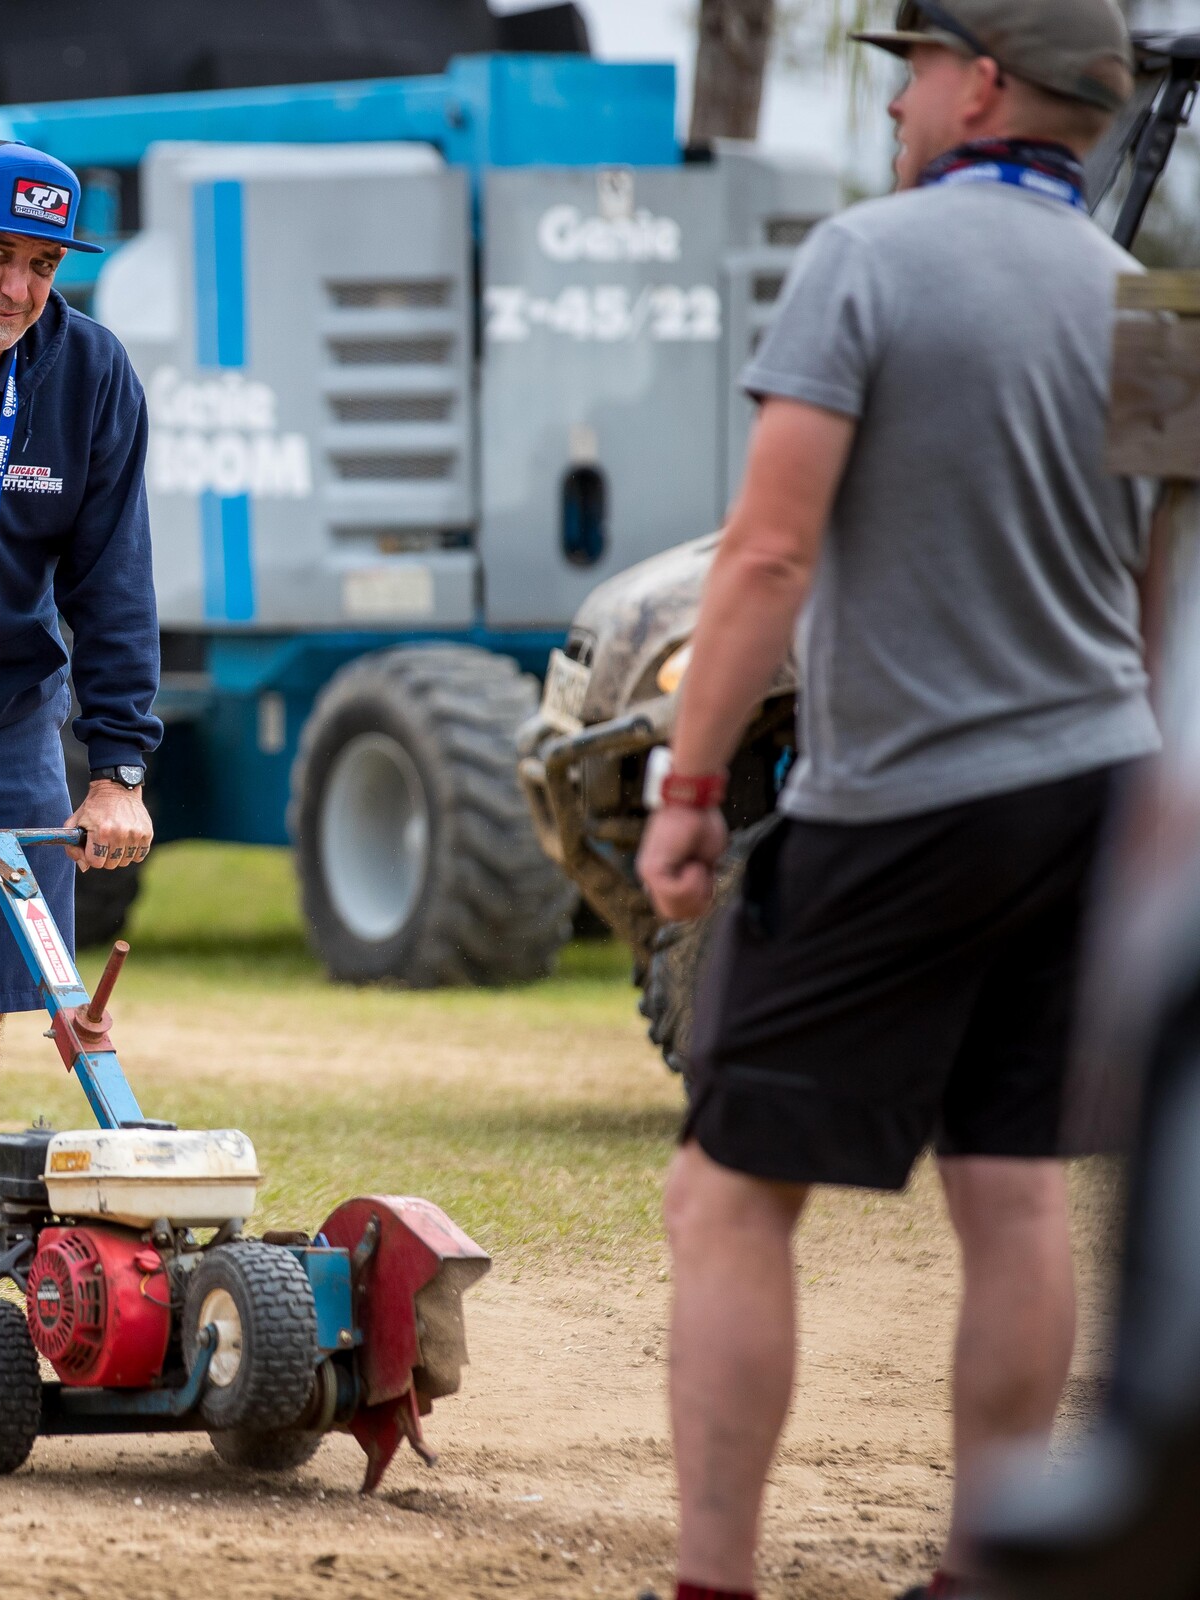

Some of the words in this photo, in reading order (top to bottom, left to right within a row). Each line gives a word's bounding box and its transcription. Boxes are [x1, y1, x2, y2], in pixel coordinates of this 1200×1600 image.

[538, 203, 681, 262] Genie
[484, 285, 723, 341] Z-45/22
[5, 376, 14, 407] YAMAHA
[2, 478, 63, 490] OTOCROSS
[10, 466, 35, 476] LUCAS
[36, 468, 48, 476] OIL
